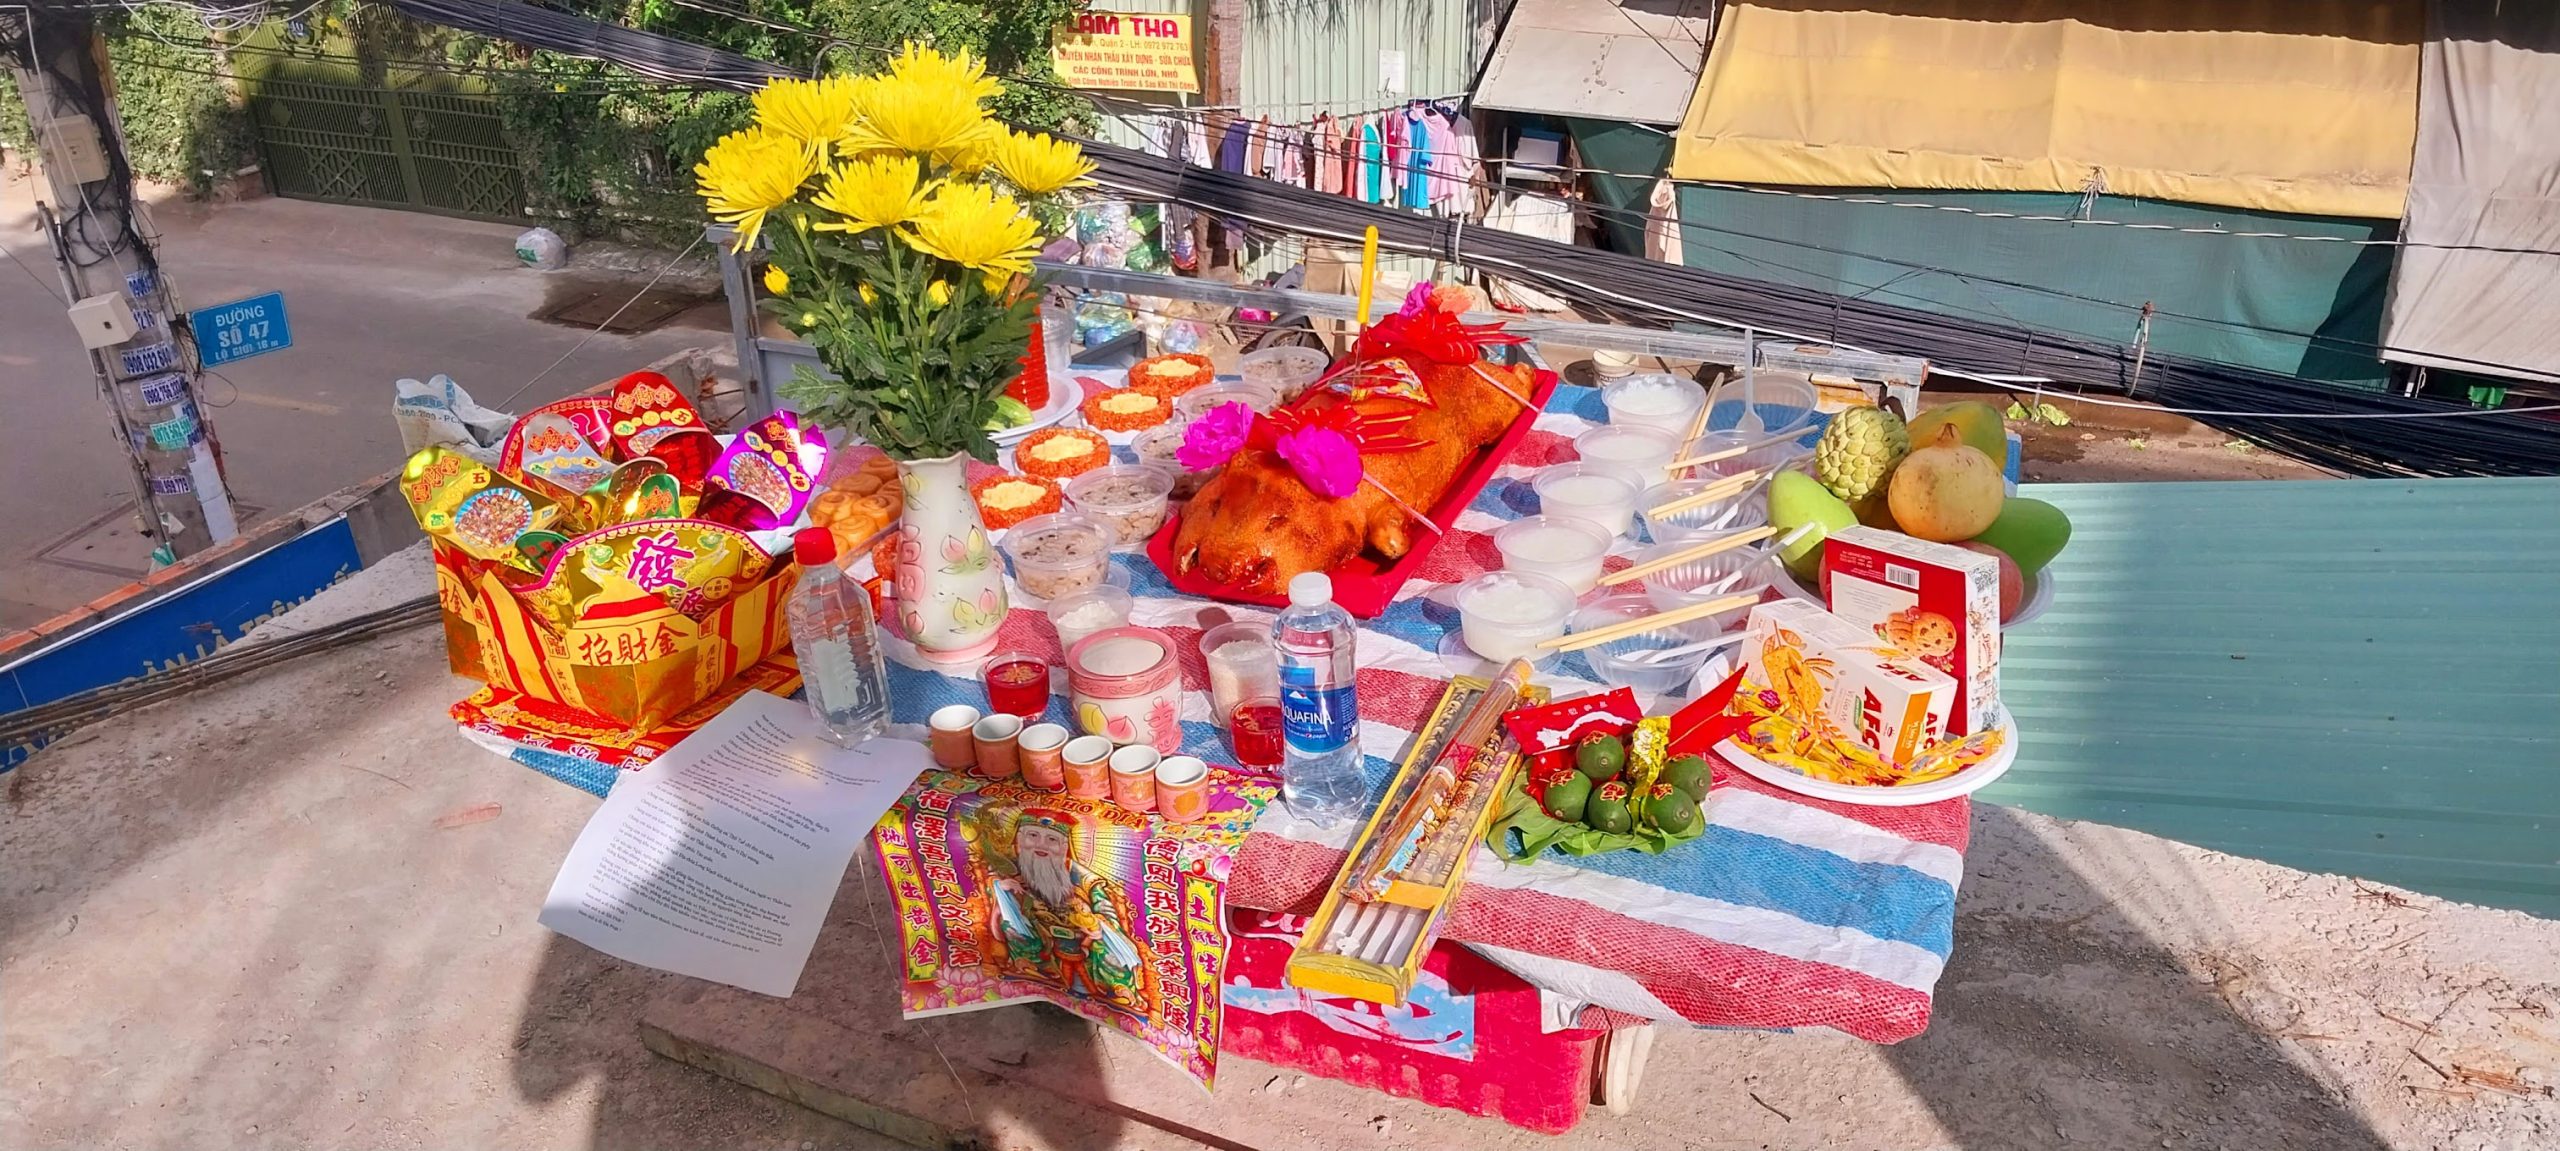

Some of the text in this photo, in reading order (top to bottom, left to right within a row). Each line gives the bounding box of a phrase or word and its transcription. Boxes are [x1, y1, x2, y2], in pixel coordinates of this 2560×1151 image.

[215, 304, 265, 327] ĐƯỜNG
[218, 321, 270, 348] SỐ 47
[472, 472, 486, 485] 五
[580, 621, 690, 667] 招財金
[1282, 704, 1334, 725] QUAFINA
[1862, 685, 1882, 751] AFC
[1923, 712, 1938, 750] AFC
